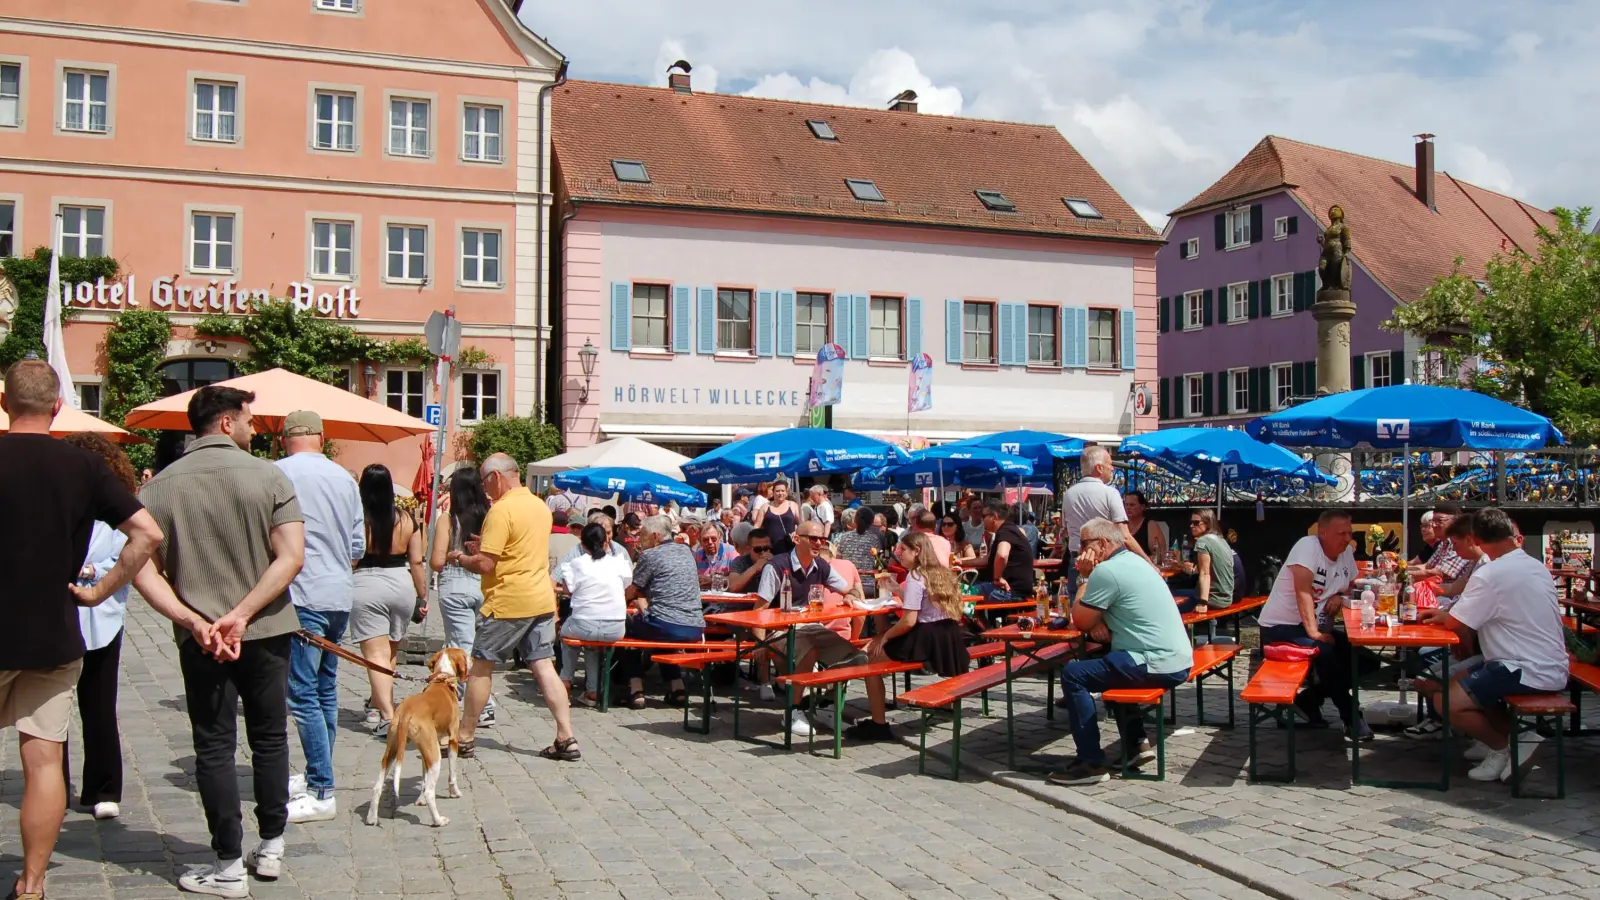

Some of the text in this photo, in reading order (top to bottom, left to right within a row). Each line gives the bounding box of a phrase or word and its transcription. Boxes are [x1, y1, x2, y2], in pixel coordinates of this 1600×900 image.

[614, 384, 798, 406] HÖRWELT WILLECKE
[1480, 421, 1496, 429] Bank
